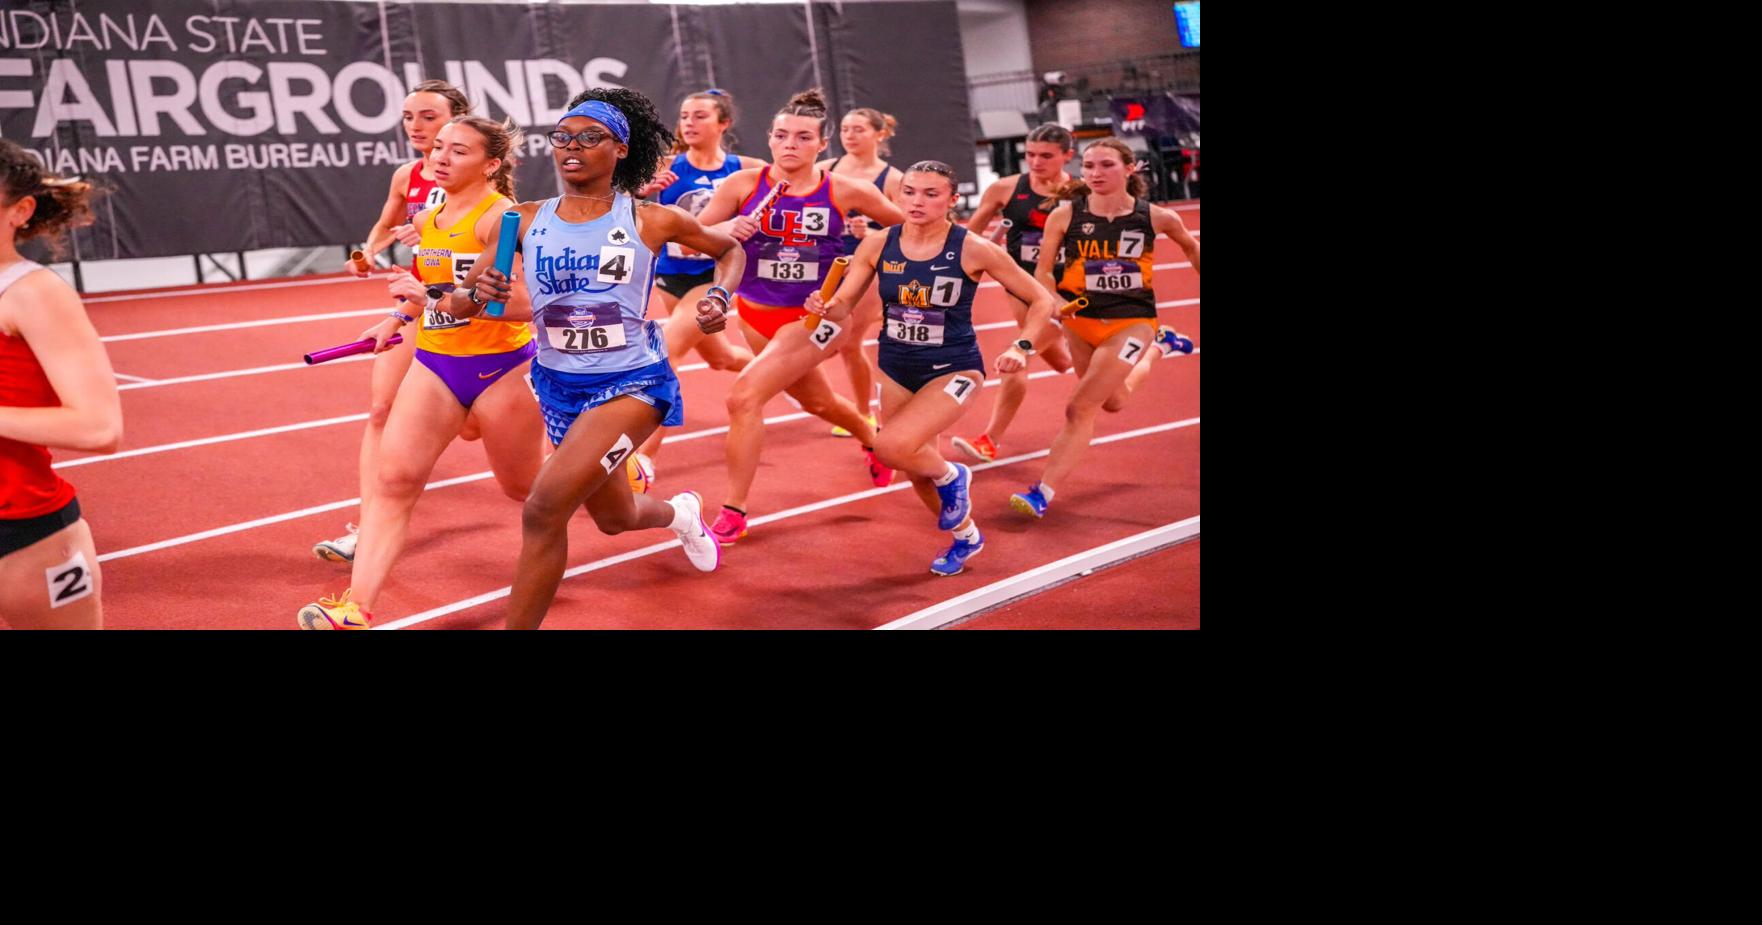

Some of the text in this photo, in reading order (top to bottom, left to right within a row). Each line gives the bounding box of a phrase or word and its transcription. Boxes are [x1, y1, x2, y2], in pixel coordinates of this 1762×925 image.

[0, 9, 327, 55] DIANA STATE
[131, 145, 219, 173] FARM
[227, 143, 350, 170] BUREAU
[805, 212, 825, 231] 3
[945, 251, 956, 261] C
[1123, 237, 1141, 255] 7
[424, 258, 441, 267] IOWA
[455, 259, 475, 281] 5
[599, 254, 627, 281] 4
[770, 262, 805, 280] 133
[535, 272, 618, 296] State
[936, 281, 954, 303] 1
[1096, 275, 1132, 290] 460
[562, 327, 609, 350] 276
[815, 324, 834, 344] 3
[897, 323, 930, 342] 318
[1124, 342, 1141, 360] 7
[954, 378, 971, 398] 1
[605, 447, 628, 470] 4
[53, 566, 88, 602] 2
